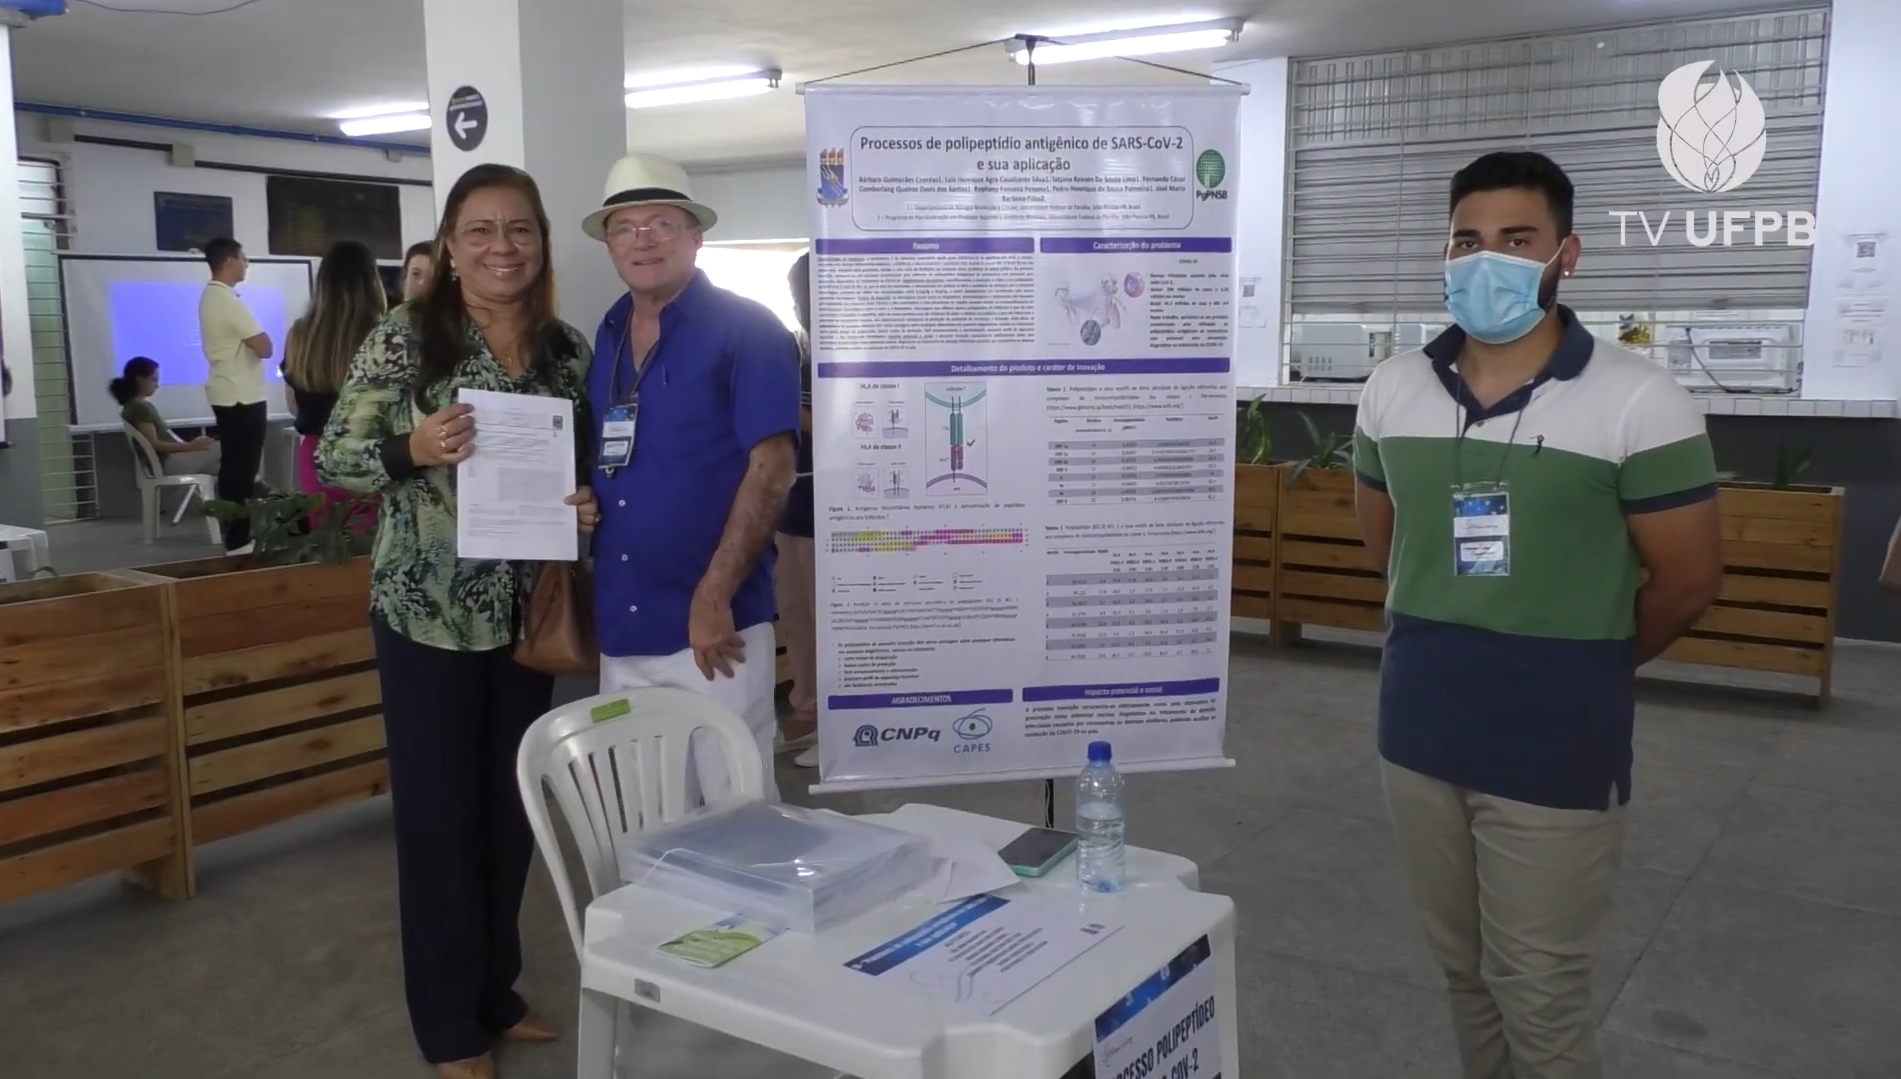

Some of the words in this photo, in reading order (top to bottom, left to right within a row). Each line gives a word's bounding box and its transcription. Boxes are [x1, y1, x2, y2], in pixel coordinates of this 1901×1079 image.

[861, 136, 923, 150] Processos
[926, 137, 943, 150] de
[946, 135, 1022, 153] polipeptídio
[1025, 135, 1090, 154] antigênico
[1092, 137, 1108, 150] de
[1111, 136, 1184, 150] SARS-CoV-2
[977, 160, 986, 170] e
[988, 160, 1010, 170] sua
[1013, 157, 1072, 174] aplicação
[1196, 190, 1228, 202] PgPNSB
[912, 242, 940, 250] Resumo
[1092, 240, 1140, 252] Caracterização
[1140, 241, 1150, 250] do
[1150, 240, 1181, 251] problema
[950, 363, 998, 373] Detalhamento
[999, 364, 1008, 373] do
[1009, 363, 1036, 374] produto
[1036, 365, 1042, 373] e
[1066, 362, 1076, 372] de
[1076, 362, 1106, 373] inovação
[1110, 686, 1139, 697] potencial
[890, 694, 952, 706] AGRADECIMENTOS
[881, 726, 943, 744] CNPq
[953, 742, 991, 755] CAPES
[1112, 1047, 1154, 1079] CESSO
[1156, 994, 1216, 1066] POLIPEPTÍDEO
